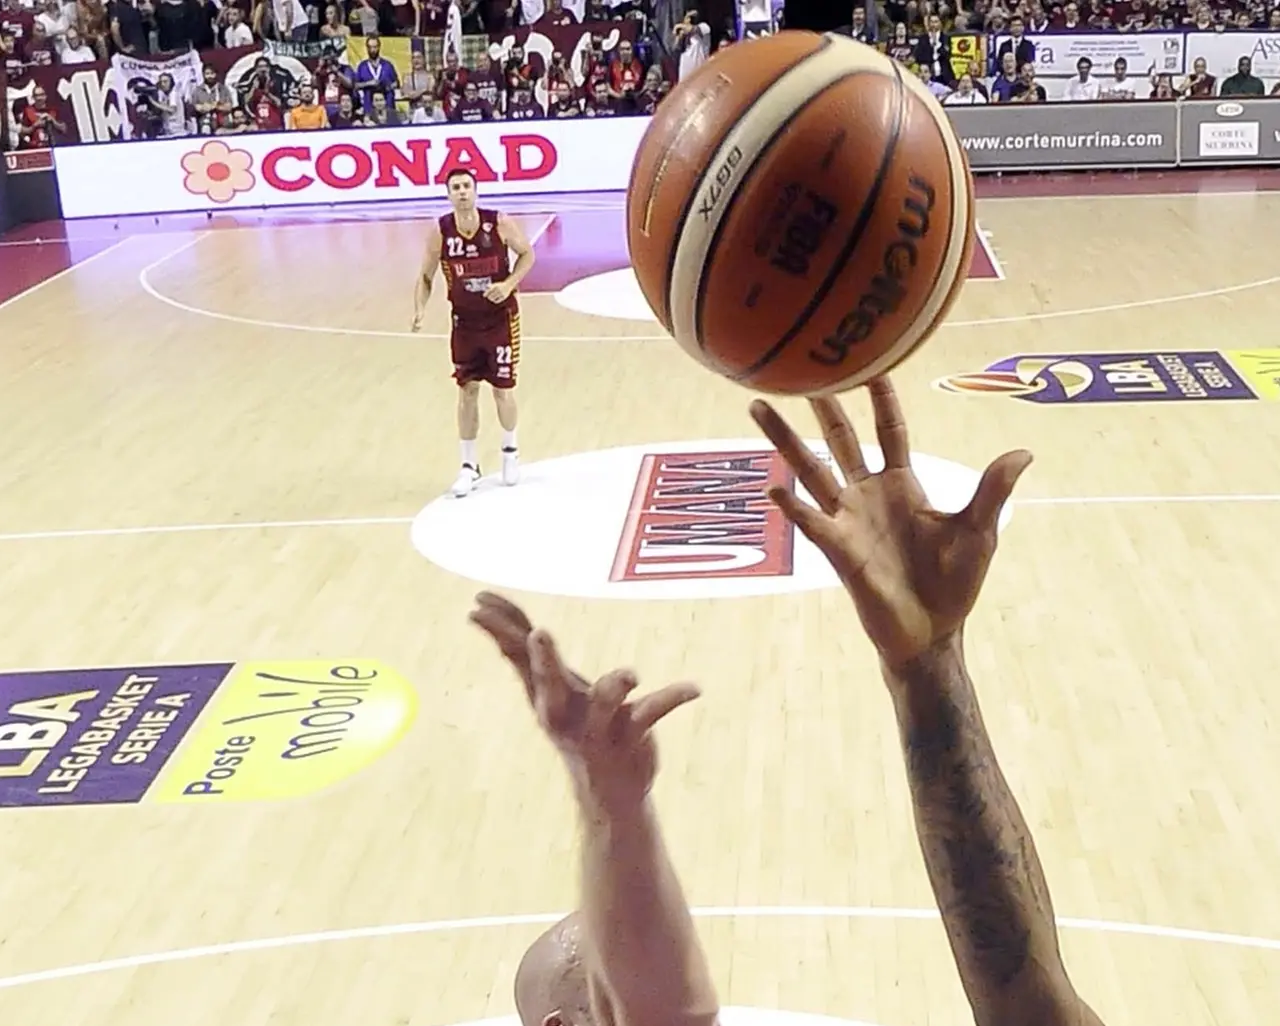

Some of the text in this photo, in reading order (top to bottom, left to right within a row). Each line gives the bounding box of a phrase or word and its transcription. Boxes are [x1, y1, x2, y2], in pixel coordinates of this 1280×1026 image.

[261, 134, 558, 192] CONAD
[960, 131, 1162, 149] www.cortemurrina.com
[447, 237, 465, 257] 22
[496, 346, 512, 364] 22
[1099, 359, 1168, 393] LBA
[37, 672, 161, 795] LEGABASKET
[111, 692, 192, 764] SERIE A
[182, 733, 256, 797] Poste
